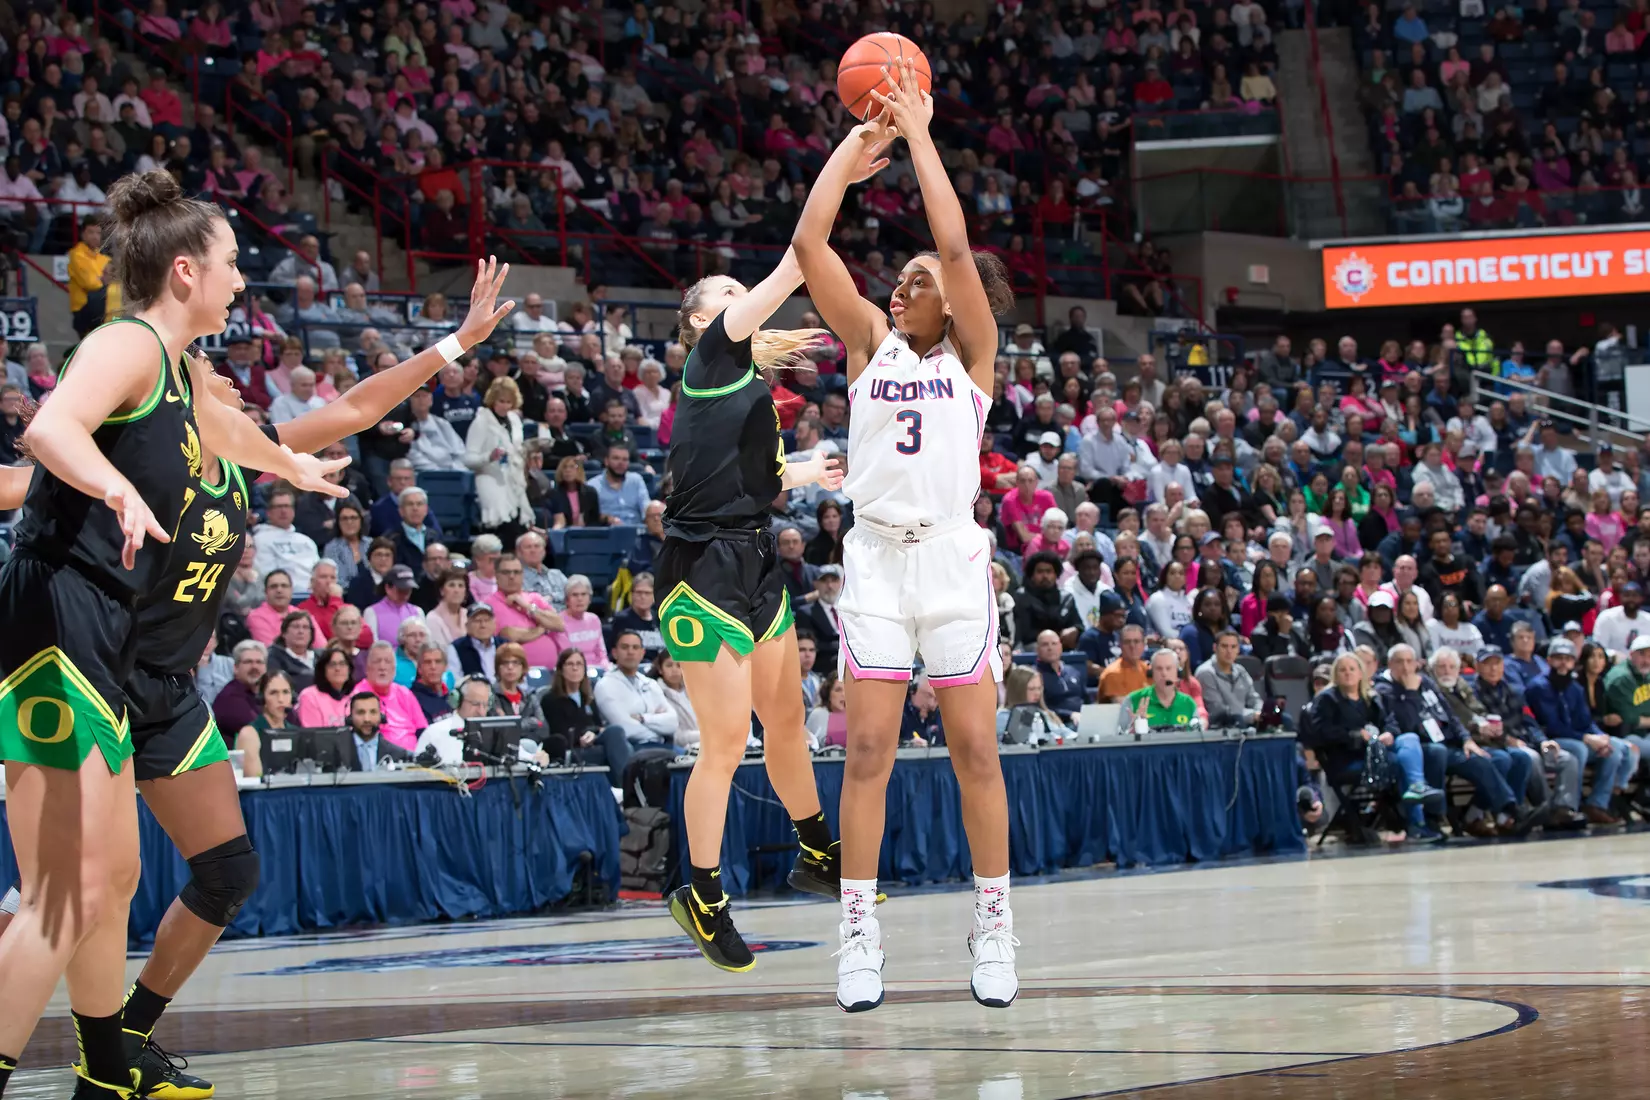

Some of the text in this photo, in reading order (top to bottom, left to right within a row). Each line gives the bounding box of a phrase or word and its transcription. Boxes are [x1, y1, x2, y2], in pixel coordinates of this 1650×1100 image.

[1386, 248, 1650, 288] CONNECTICUT S
[870, 378, 954, 402] UCONN
[896, 409, 923, 455] 3
[173, 561, 226, 604] 24
[668, 615, 704, 647] O
[17, 696, 75, 744] O
